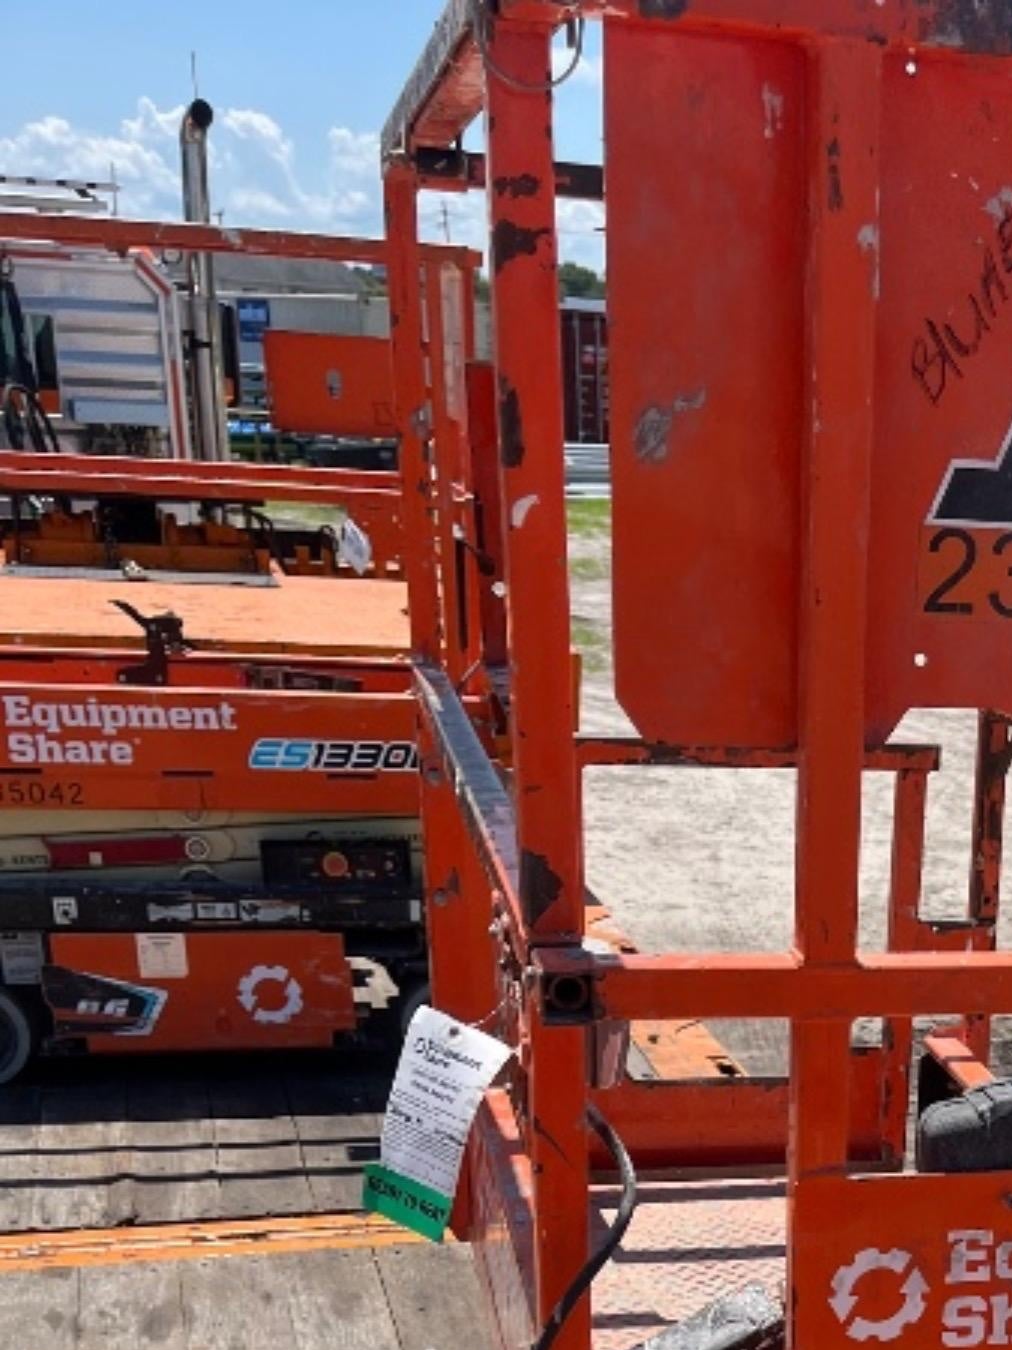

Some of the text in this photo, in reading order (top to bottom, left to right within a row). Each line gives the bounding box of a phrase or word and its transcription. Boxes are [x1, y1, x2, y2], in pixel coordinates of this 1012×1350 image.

[3, 695, 238, 736] Equipment
[8, 731, 134, 766] Share
[0, 780, 85, 805] 5042
